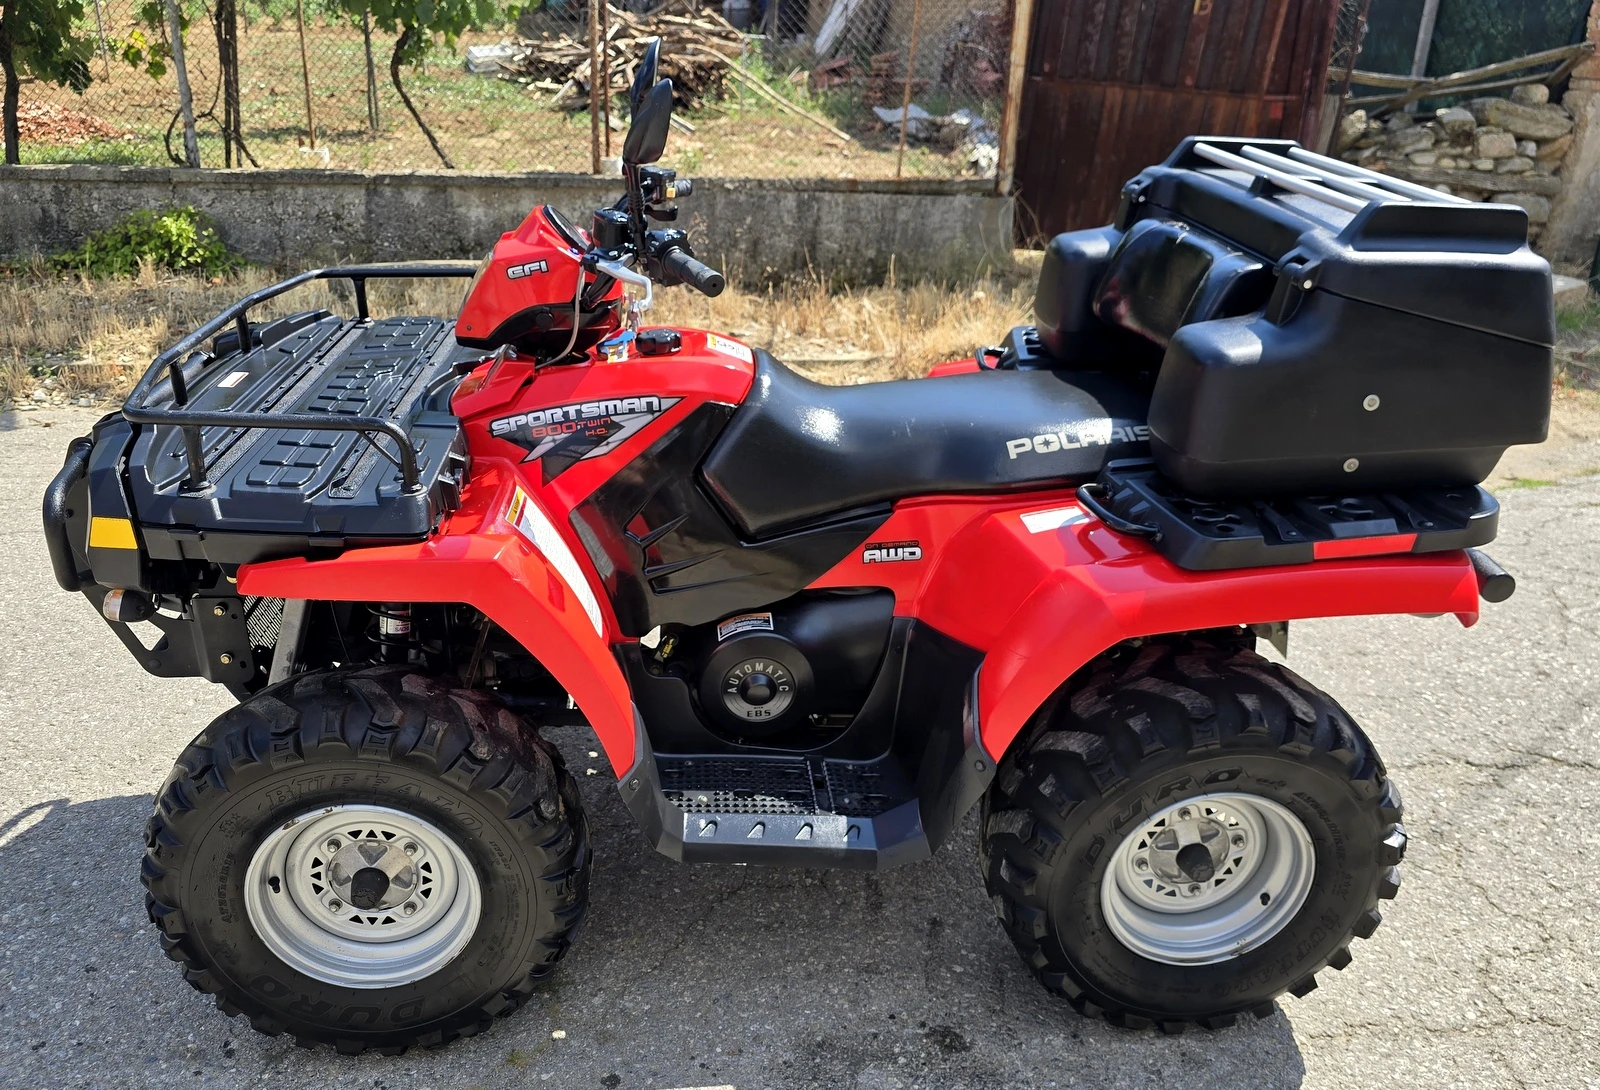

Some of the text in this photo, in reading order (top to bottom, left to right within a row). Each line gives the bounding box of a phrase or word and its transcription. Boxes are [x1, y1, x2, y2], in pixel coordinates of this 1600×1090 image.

[507, 260, 548, 279] EFI
[490, 396, 661, 437] SPORTSMAN
[531, 417, 611, 438] 800 TWIN
[863, 546, 922, 563] AWD
[727, 662, 789, 693] AUTOMATIC
[746, 710, 771, 718] EBS
[265, 773, 484, 832] BUFFALO
[1080, 766, 1245, 871] DURO
[249, 973, 427, 1026] DURO
